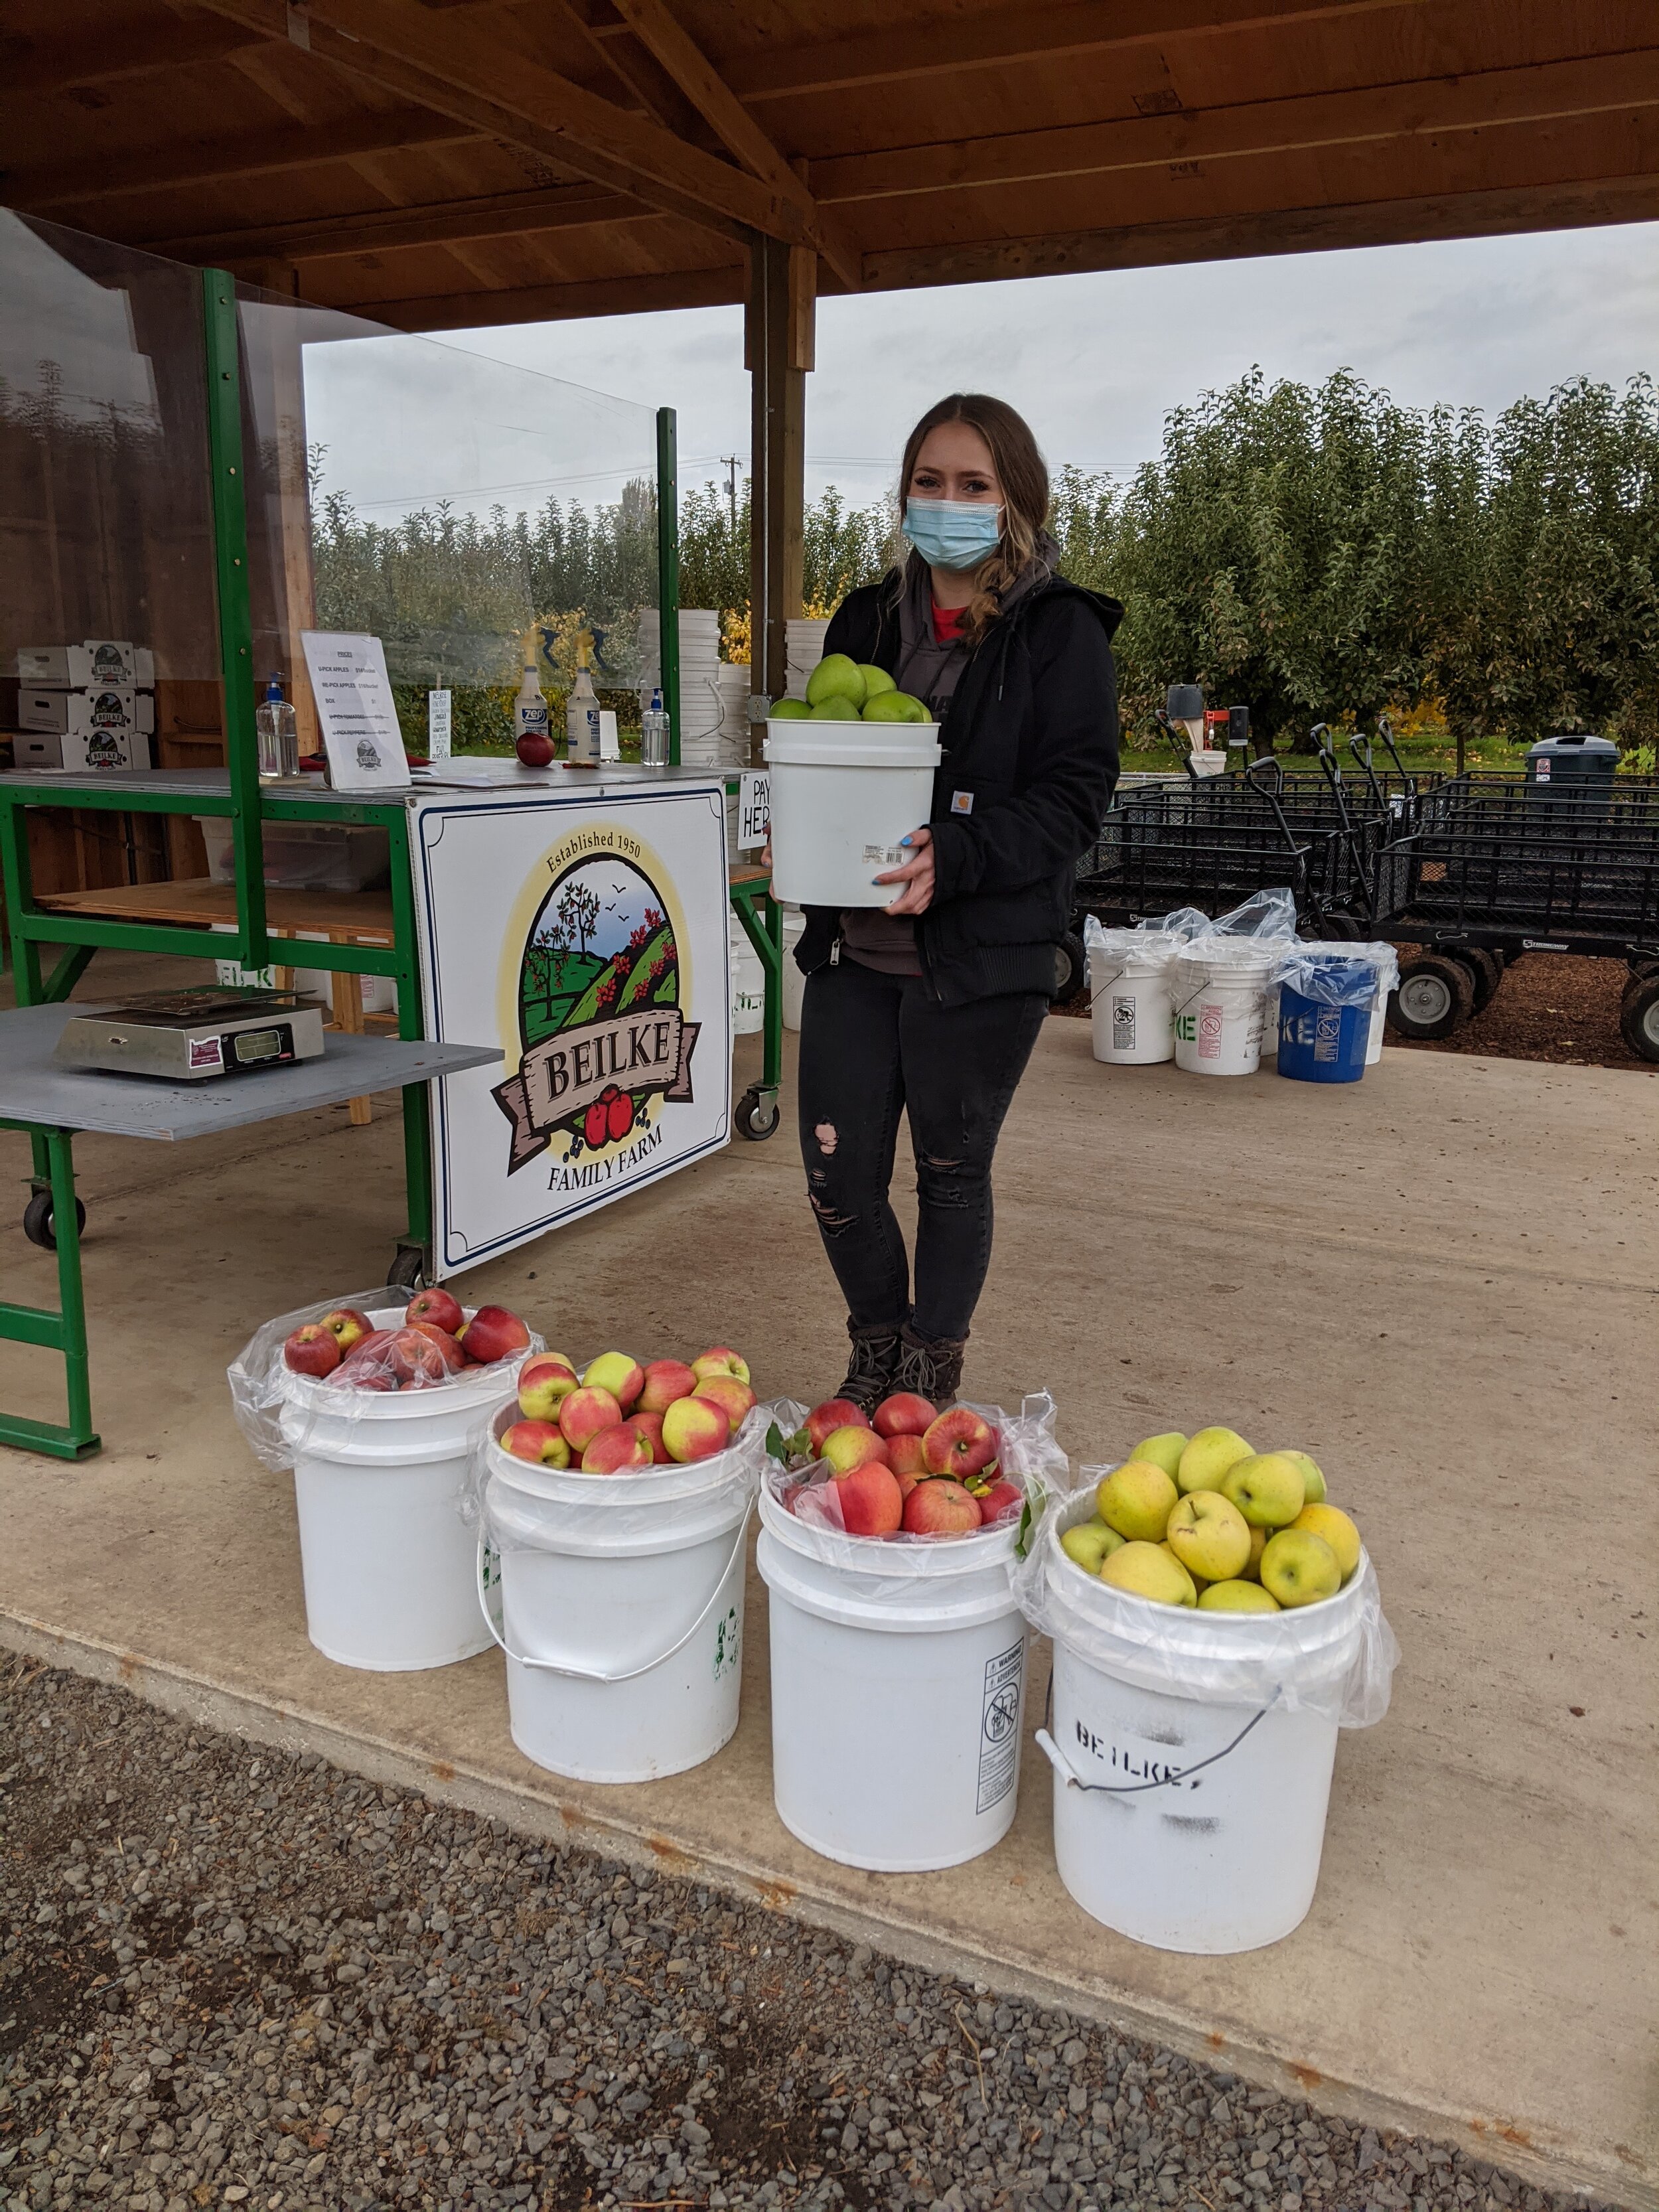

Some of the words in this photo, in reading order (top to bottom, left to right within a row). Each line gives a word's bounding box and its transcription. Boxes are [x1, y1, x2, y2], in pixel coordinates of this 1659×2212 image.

[99, 665, 121, 674] BEILKE
[753, 778, 770, 805] PAY
[743, 806, 770, 838] HER
[546, 832, 613, 873] Established
[618, 835, 640, 858] 1950
[543, 1021, 670, 1102] BEILKE
[547, 1156, 614, 1191] FAMILY
[618, 1124, 662, 1173] FARM
[999, 1645, 1021, 1667] WARNING
